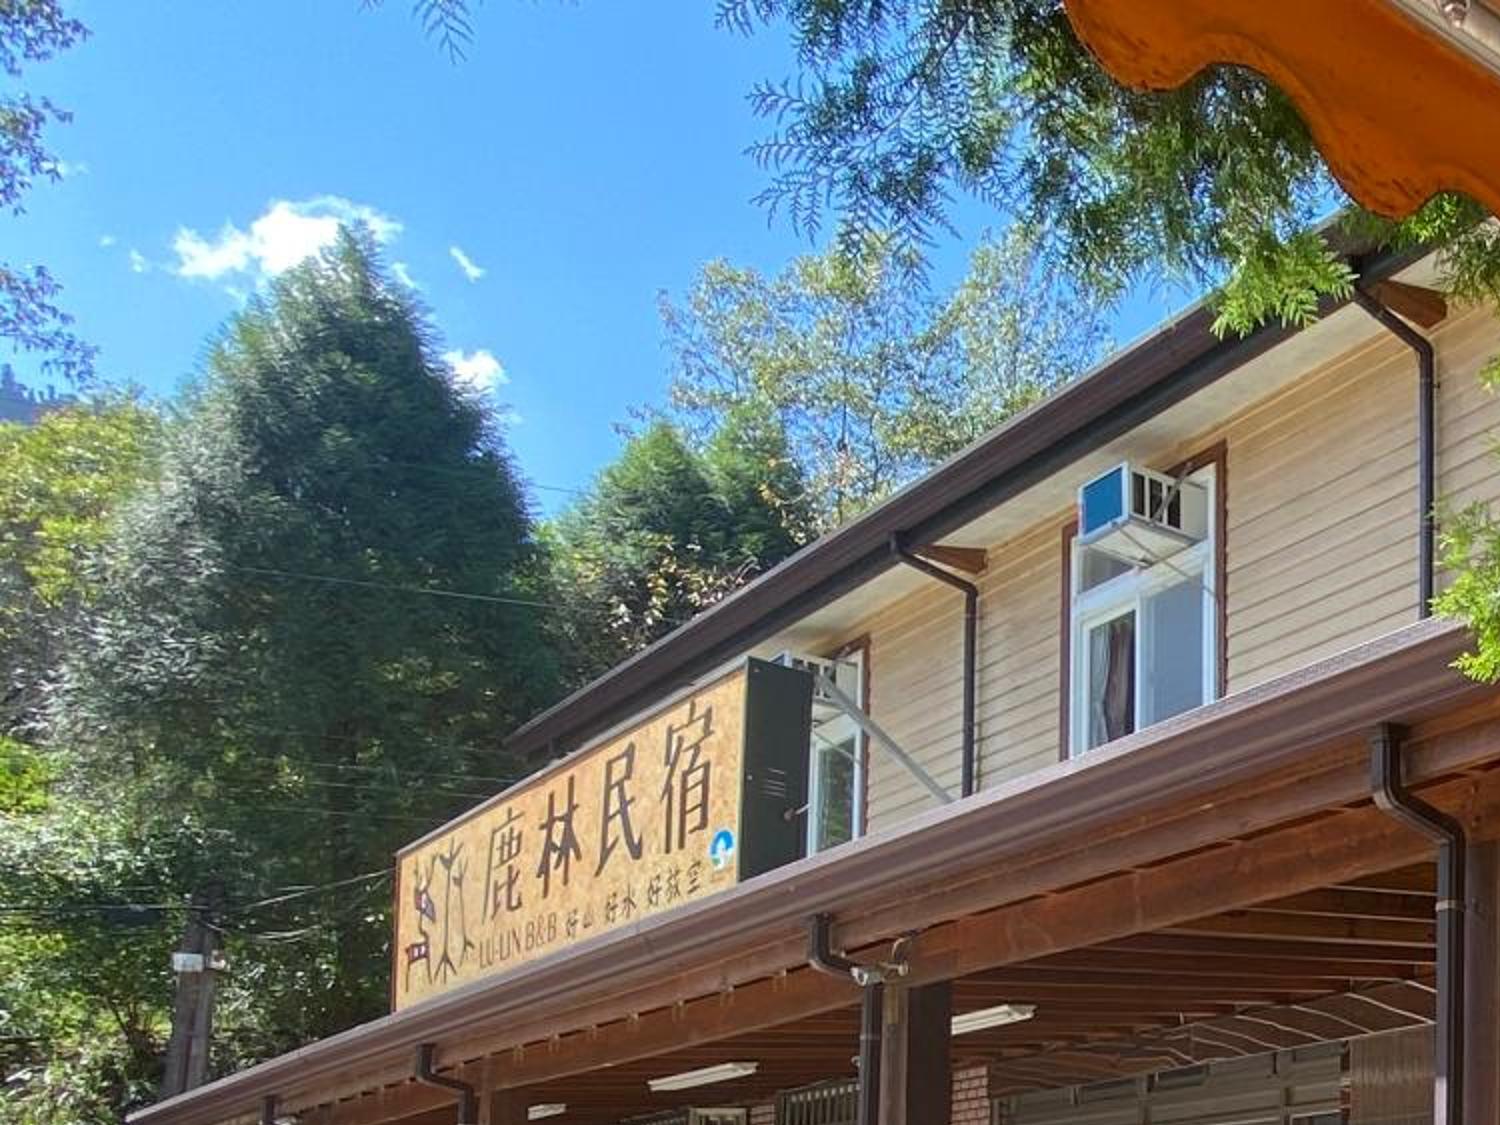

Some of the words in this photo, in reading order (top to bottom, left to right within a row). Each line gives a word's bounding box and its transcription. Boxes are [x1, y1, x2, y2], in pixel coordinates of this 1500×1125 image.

[483, 700, 714, 925] 鹿林民宿
[605, 880, 637, 923] 好水
[479, 927, 521, 969] LU-LIN
[525, 912, 557, 951] B&B
